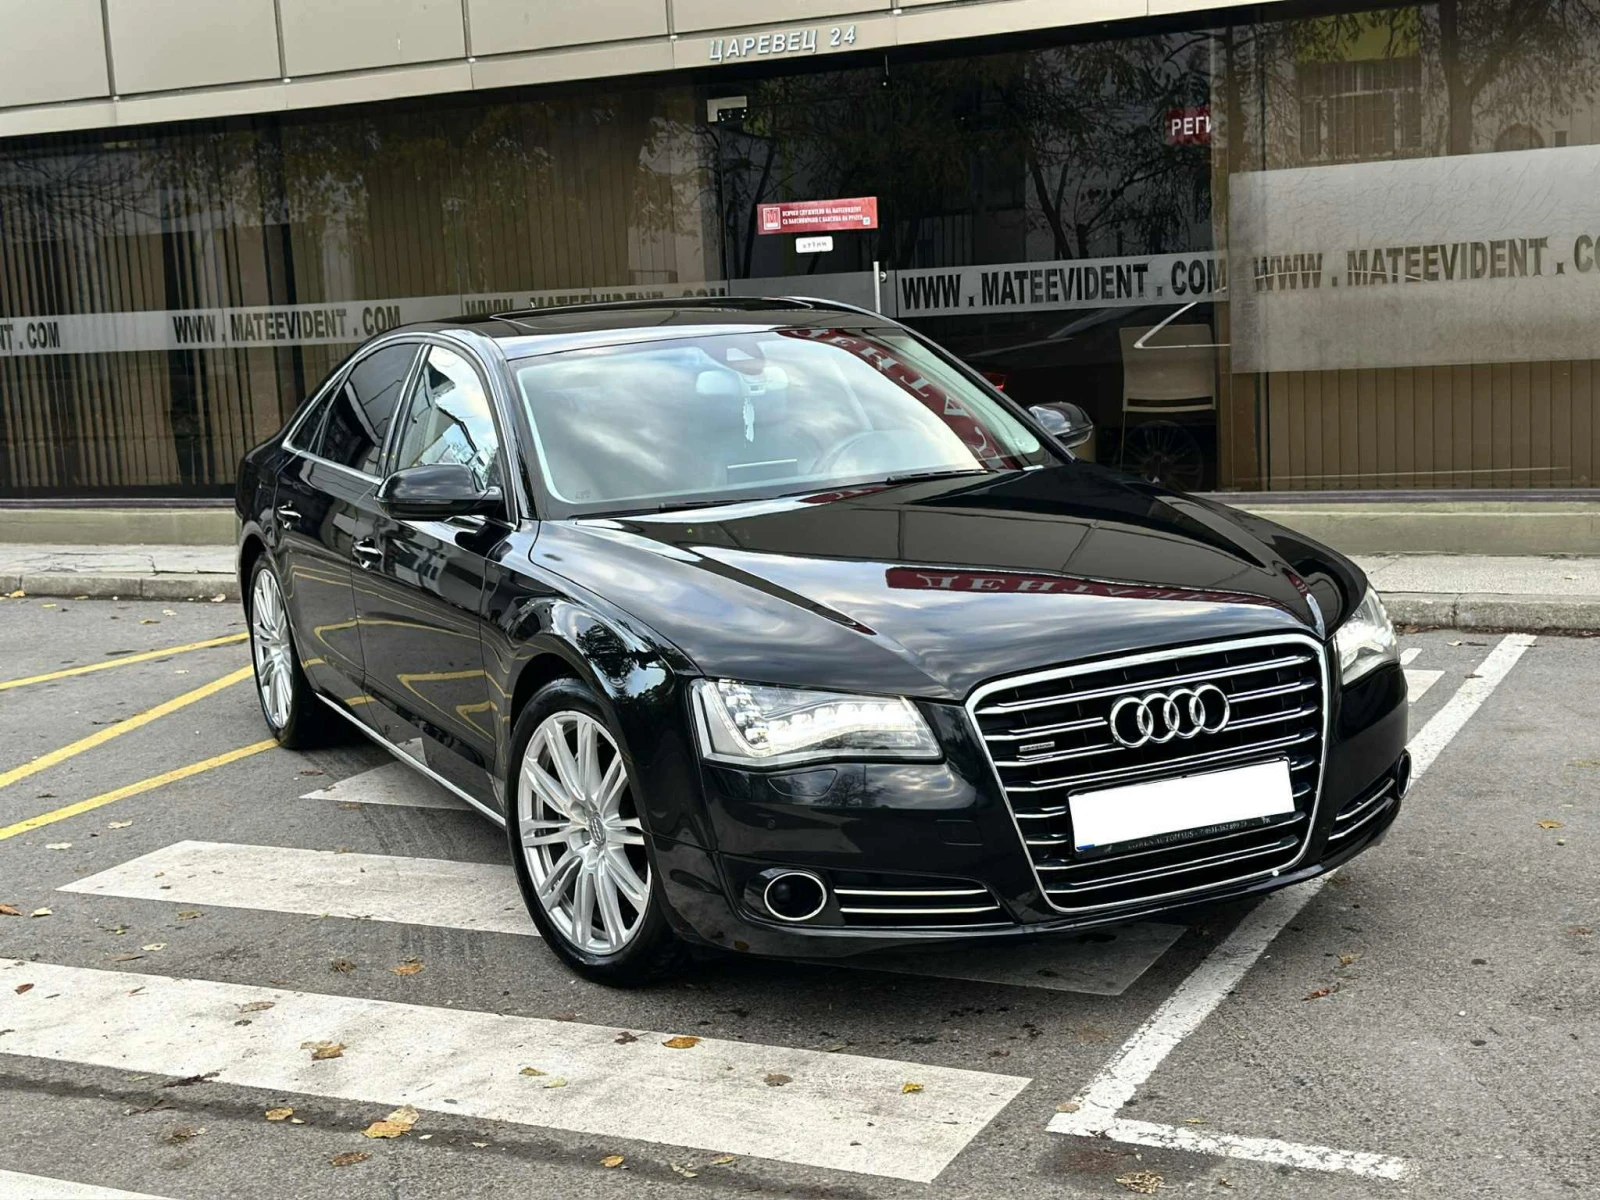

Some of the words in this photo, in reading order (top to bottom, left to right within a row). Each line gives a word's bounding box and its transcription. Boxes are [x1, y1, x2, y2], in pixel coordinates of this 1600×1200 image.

[709, 29, 818, 63] ЦАРЕВЕЦ
[830, 25, 856, 47] 24
[1347, 236, 1548, 287] MATEEVIDENT
[1573, 234, 1600, 273] C
[981, 263, 1148, 306] MATEEVIDENT
[1171, 258, 1227, 296] COM
[27, 322, 60, 349] COM
[230, 309, 346, 341] MATEEVIDENT
